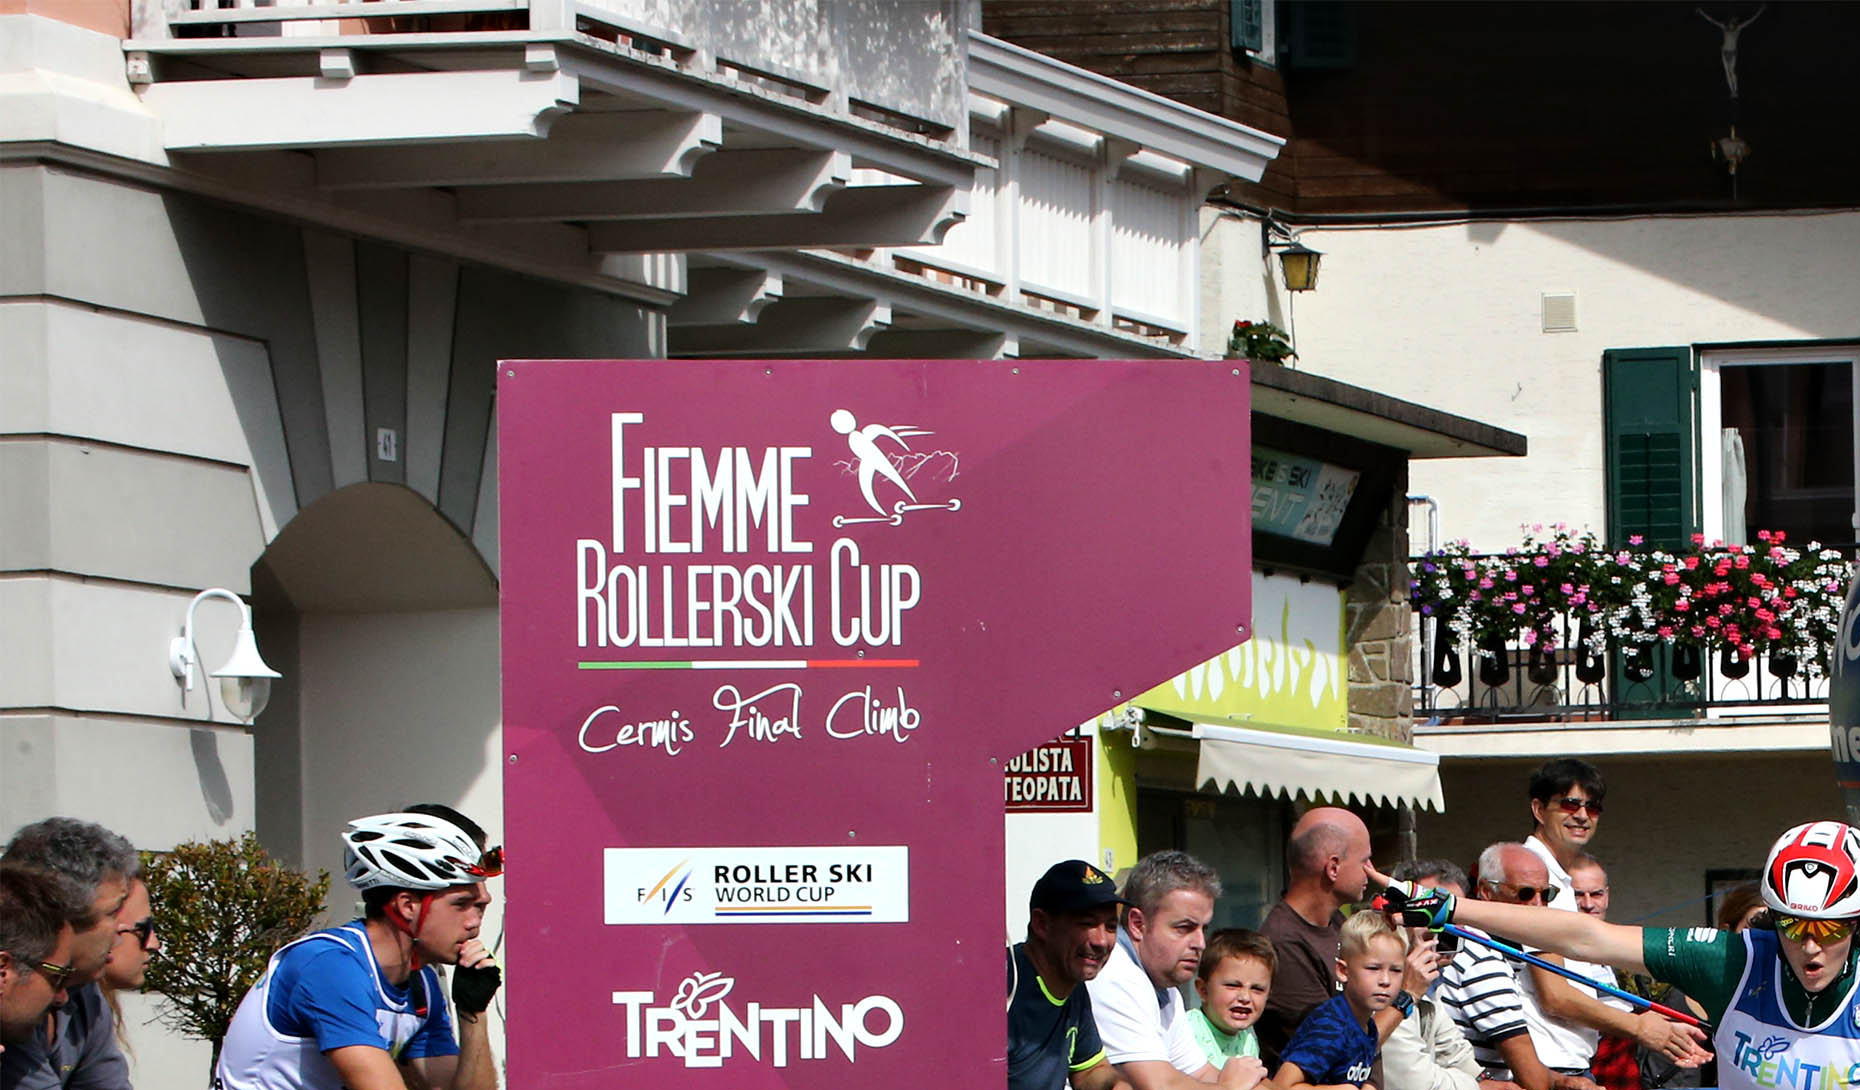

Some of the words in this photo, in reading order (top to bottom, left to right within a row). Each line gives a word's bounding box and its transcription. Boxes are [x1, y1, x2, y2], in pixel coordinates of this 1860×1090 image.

[612, 412, 813, 554] FIEMME
[578, 539, 813, 647] ROLLERSKI
[830, 537, 920, 647] CUP
[578, 706, 694, 756] Cermis
[713, 683, 802, 748] Final
[826, 686, 920, 741] Climb
[1005, 748, 1074, 772] ULISTA
[715, 865, 817, 884] ROLLER
[829, 864, 873, 883] SKI
[715, 887, 790, 903] WORLD
[796, 886, 835, 902] CUP
[612, 991, 905, 1068] TRENTINO
